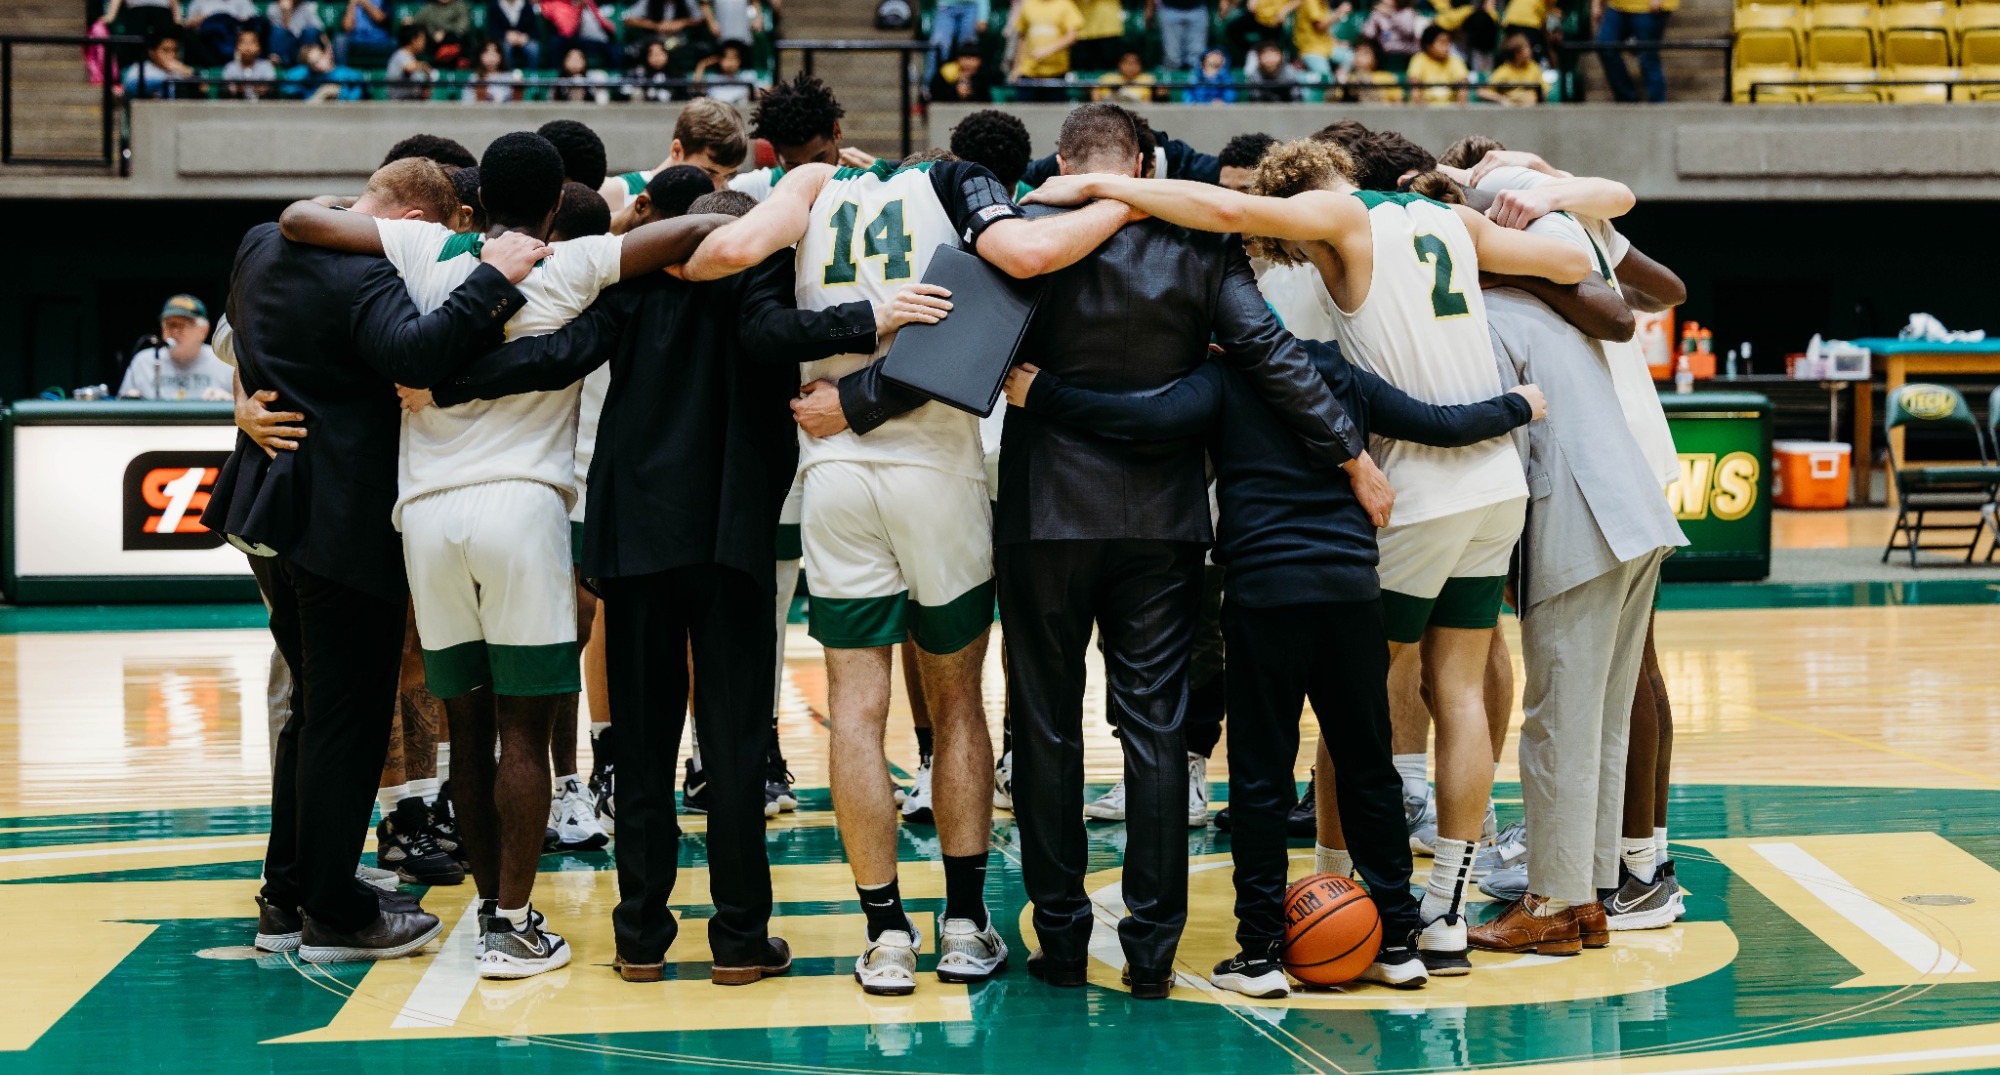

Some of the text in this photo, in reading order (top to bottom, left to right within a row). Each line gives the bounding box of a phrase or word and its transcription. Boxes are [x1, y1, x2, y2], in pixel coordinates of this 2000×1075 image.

[823, 197, 915, 288] 14
[1412, 230, 1472, 321] 2
[1285, 879, 1356, 929] THE ROCK
